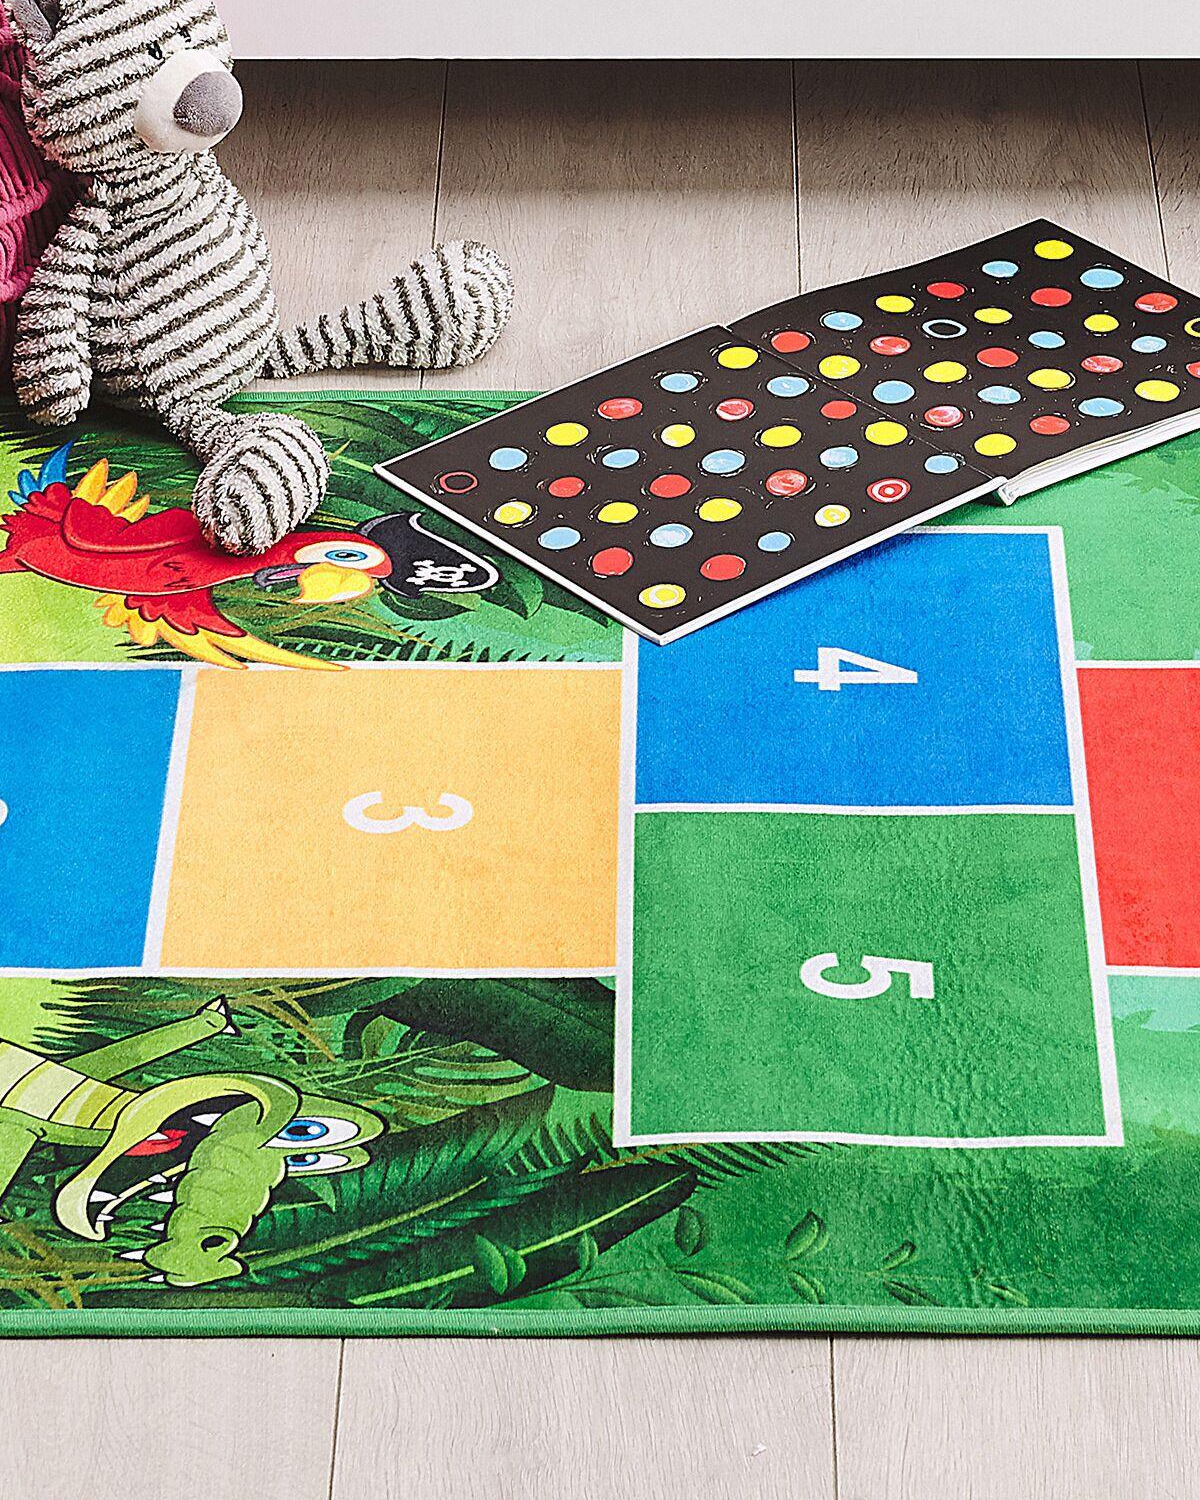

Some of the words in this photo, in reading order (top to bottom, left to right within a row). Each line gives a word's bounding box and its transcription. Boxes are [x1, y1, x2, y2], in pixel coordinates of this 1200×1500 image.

[794, 646, 918, 691] 4
[342, 790, 474, 834] 3
[800, 952, 935, 1000] 5
